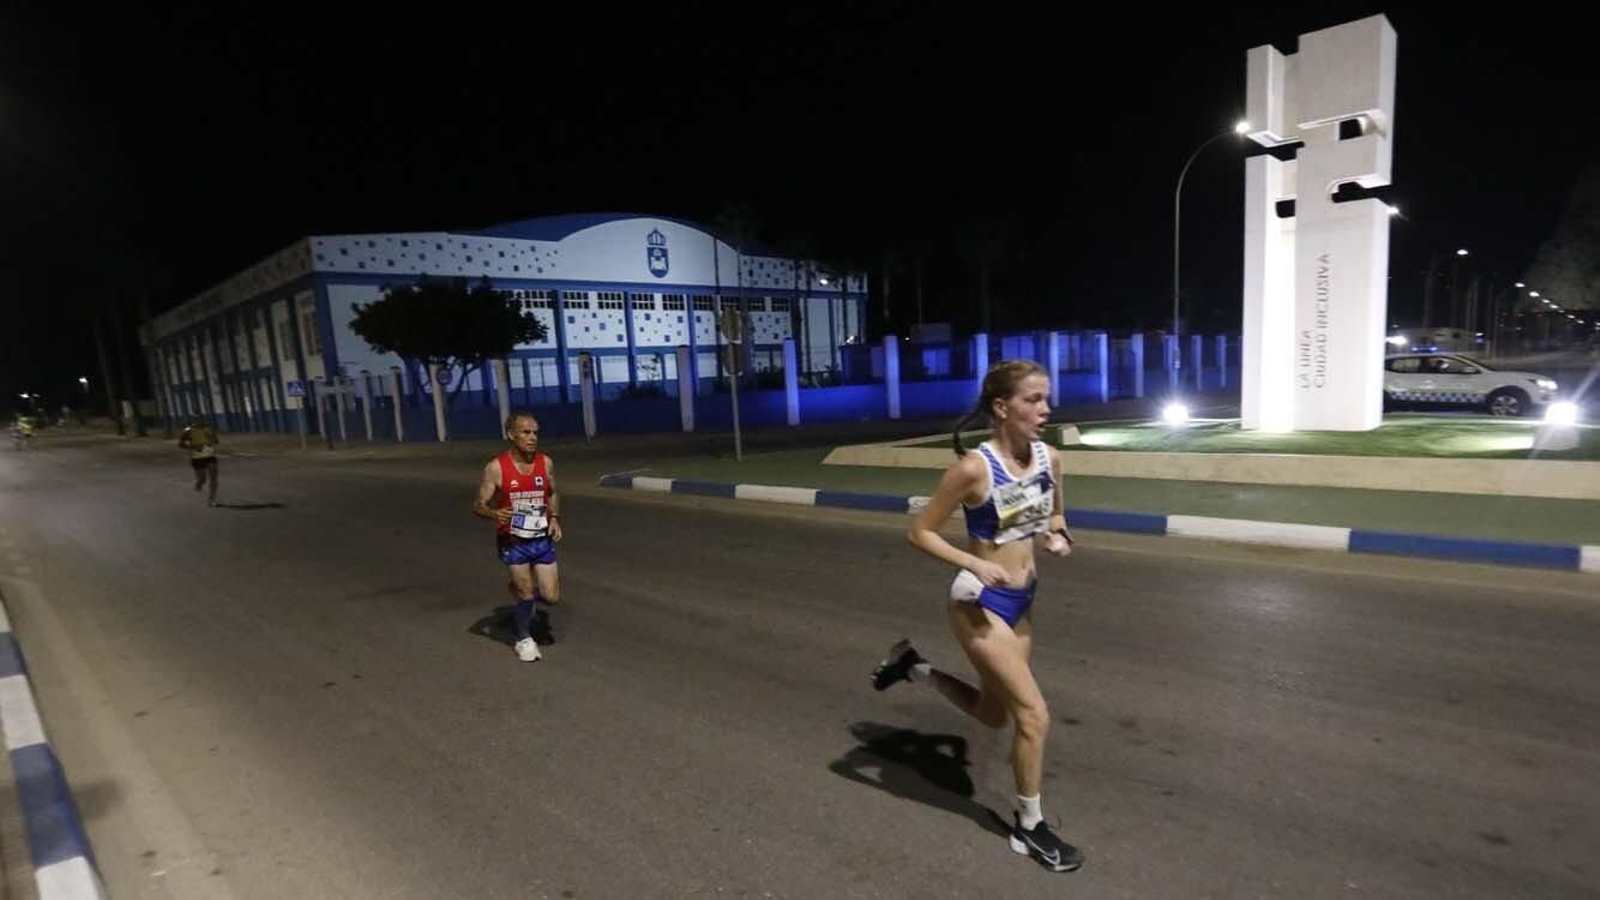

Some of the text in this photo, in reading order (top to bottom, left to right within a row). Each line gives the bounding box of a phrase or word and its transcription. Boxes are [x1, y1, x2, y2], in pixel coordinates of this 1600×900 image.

[1314, 252, 1331, 389] CIUDAD INCLUSIVA
[1299, 373, 1311, 389] LA
